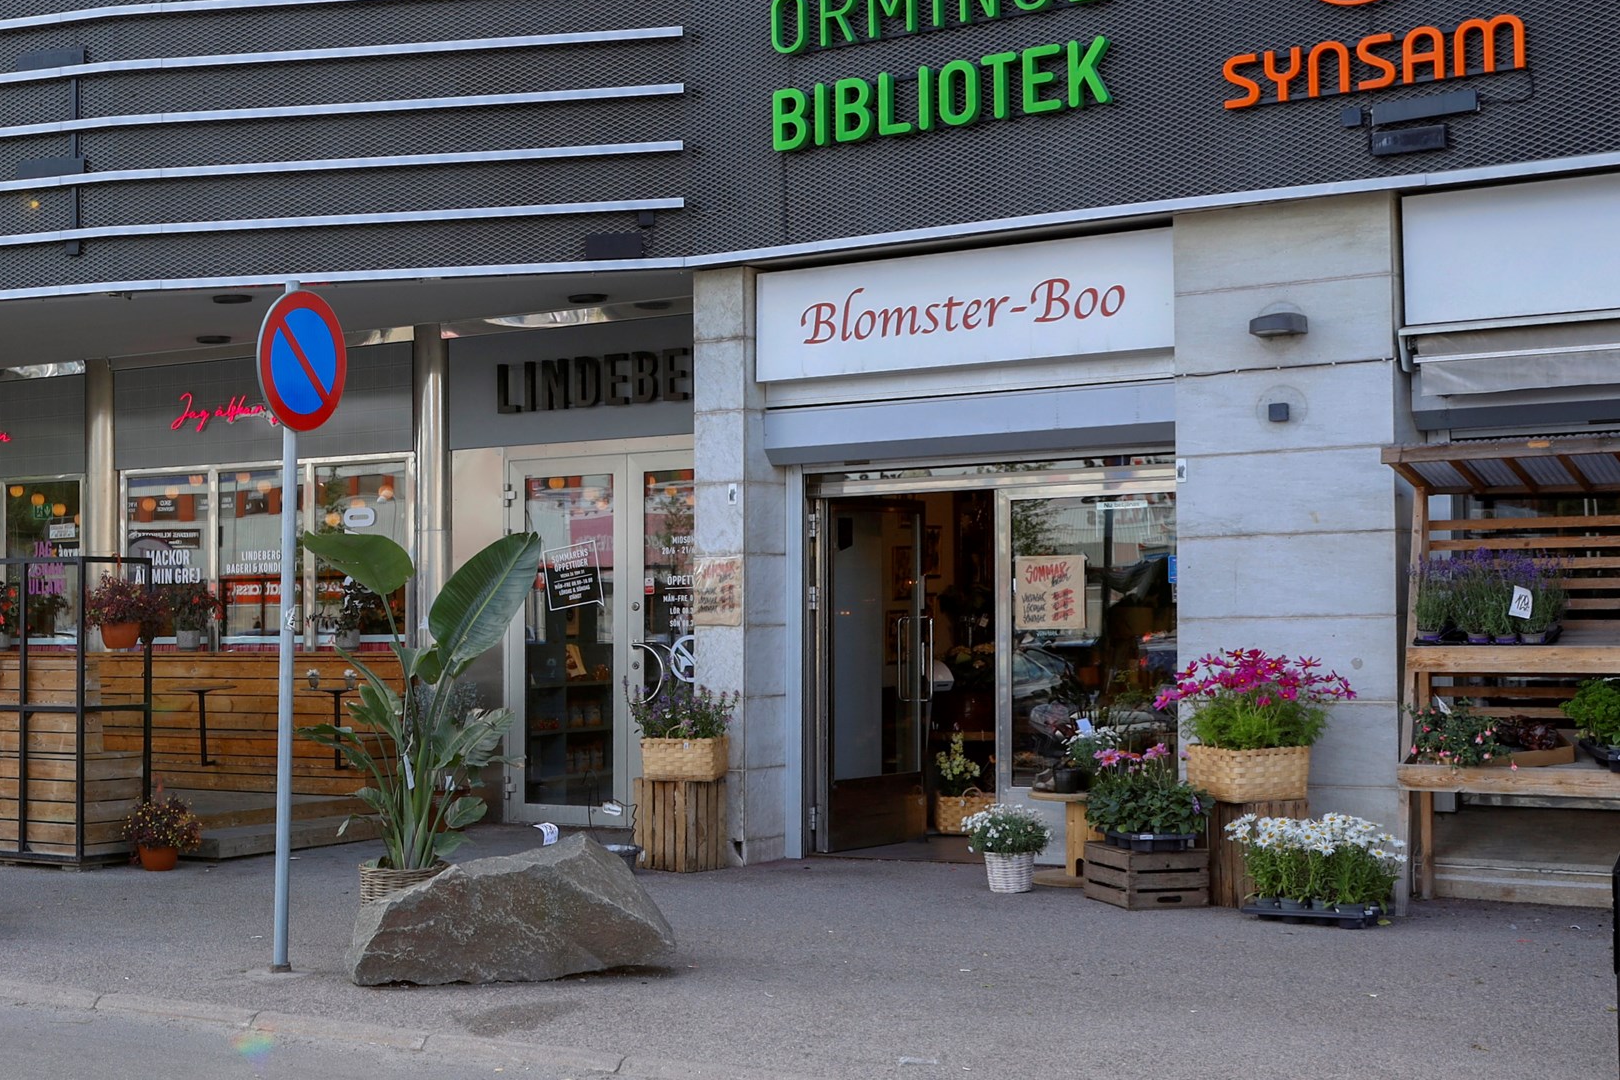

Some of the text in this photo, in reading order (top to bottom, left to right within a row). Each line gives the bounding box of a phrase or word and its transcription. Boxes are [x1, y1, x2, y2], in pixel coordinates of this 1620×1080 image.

[1222, 14, 1526, 111] SYNSAM
[771, 36, 1112, 151] BIBLIOTEK
[800, 278, 1126, 346] Blomster-Boo
[146, 549, 190, 566] MACKOR
[174, 567, 201, 585] GREJ
[226, 563, 251, 574] BAGERI
